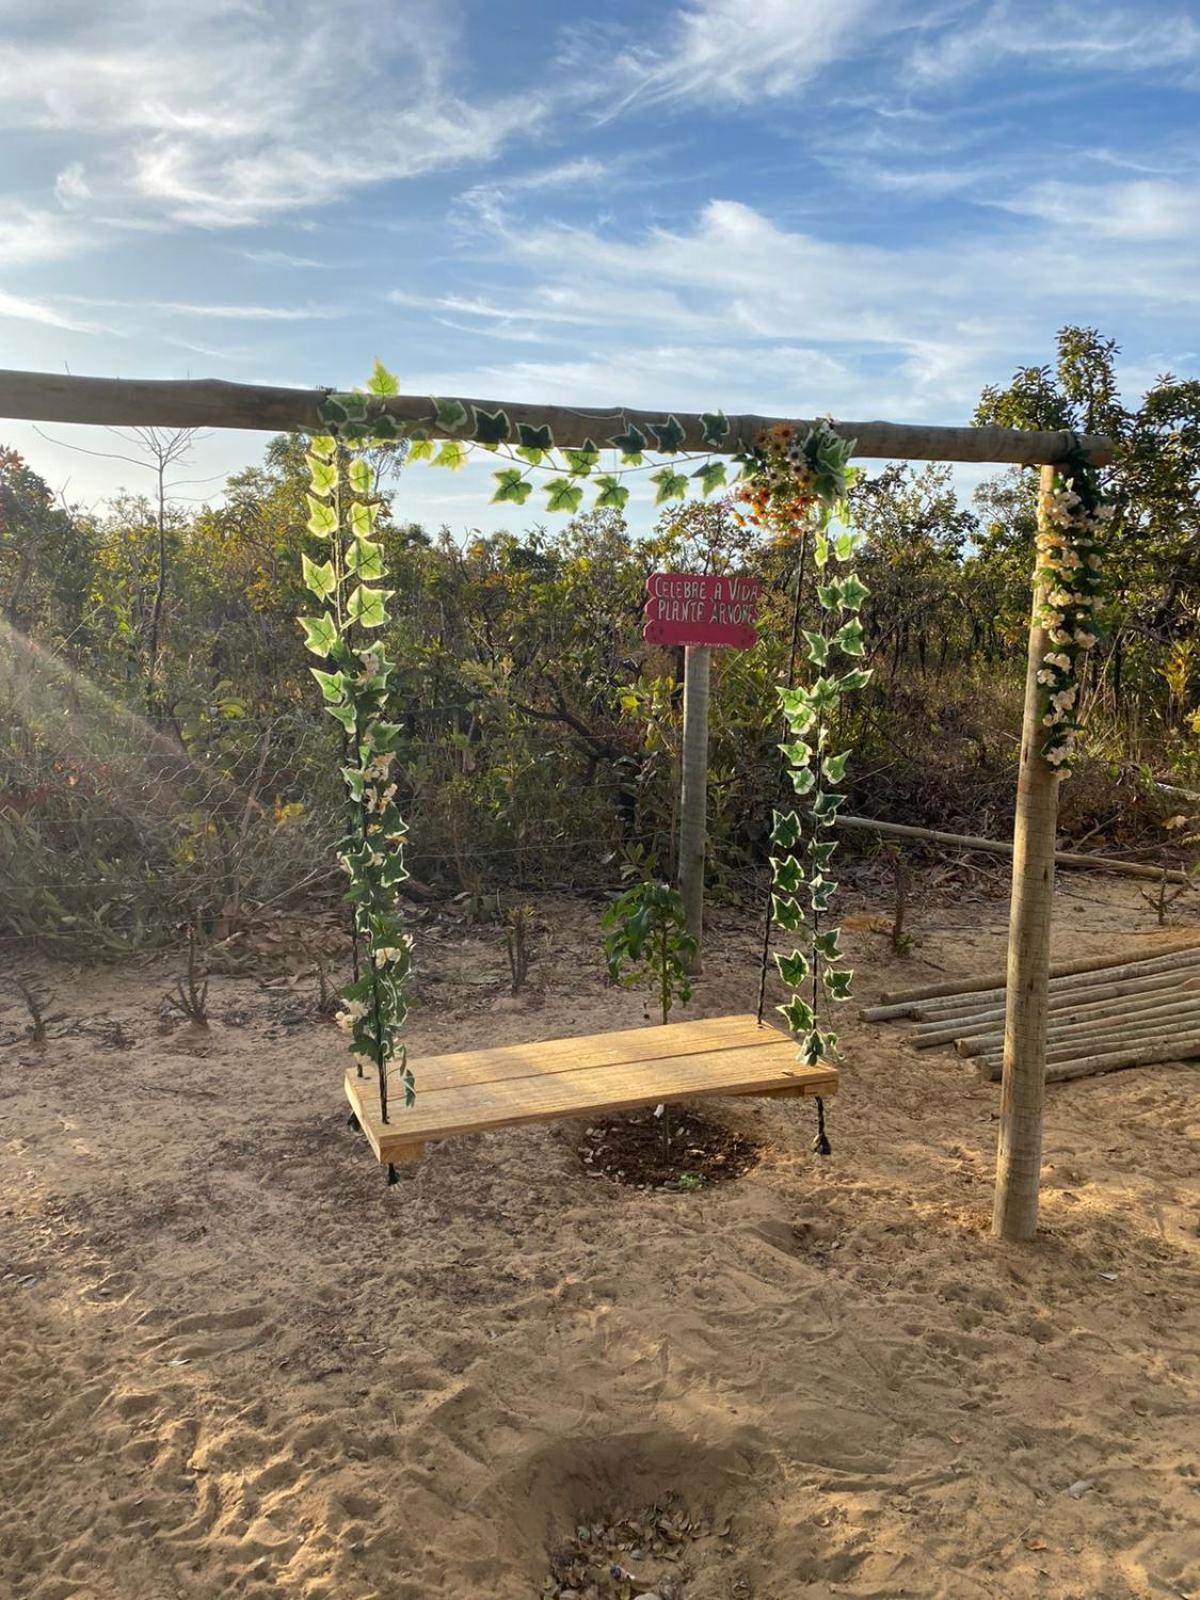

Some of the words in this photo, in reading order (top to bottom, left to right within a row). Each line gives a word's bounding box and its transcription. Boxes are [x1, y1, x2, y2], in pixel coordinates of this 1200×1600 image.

[655, 577, 706, 599] CELEBRE
[714, 583, 722, 599] A
[728, 578, 758, 600] VIDA
[658, 599, 705, 622] PLANTE
